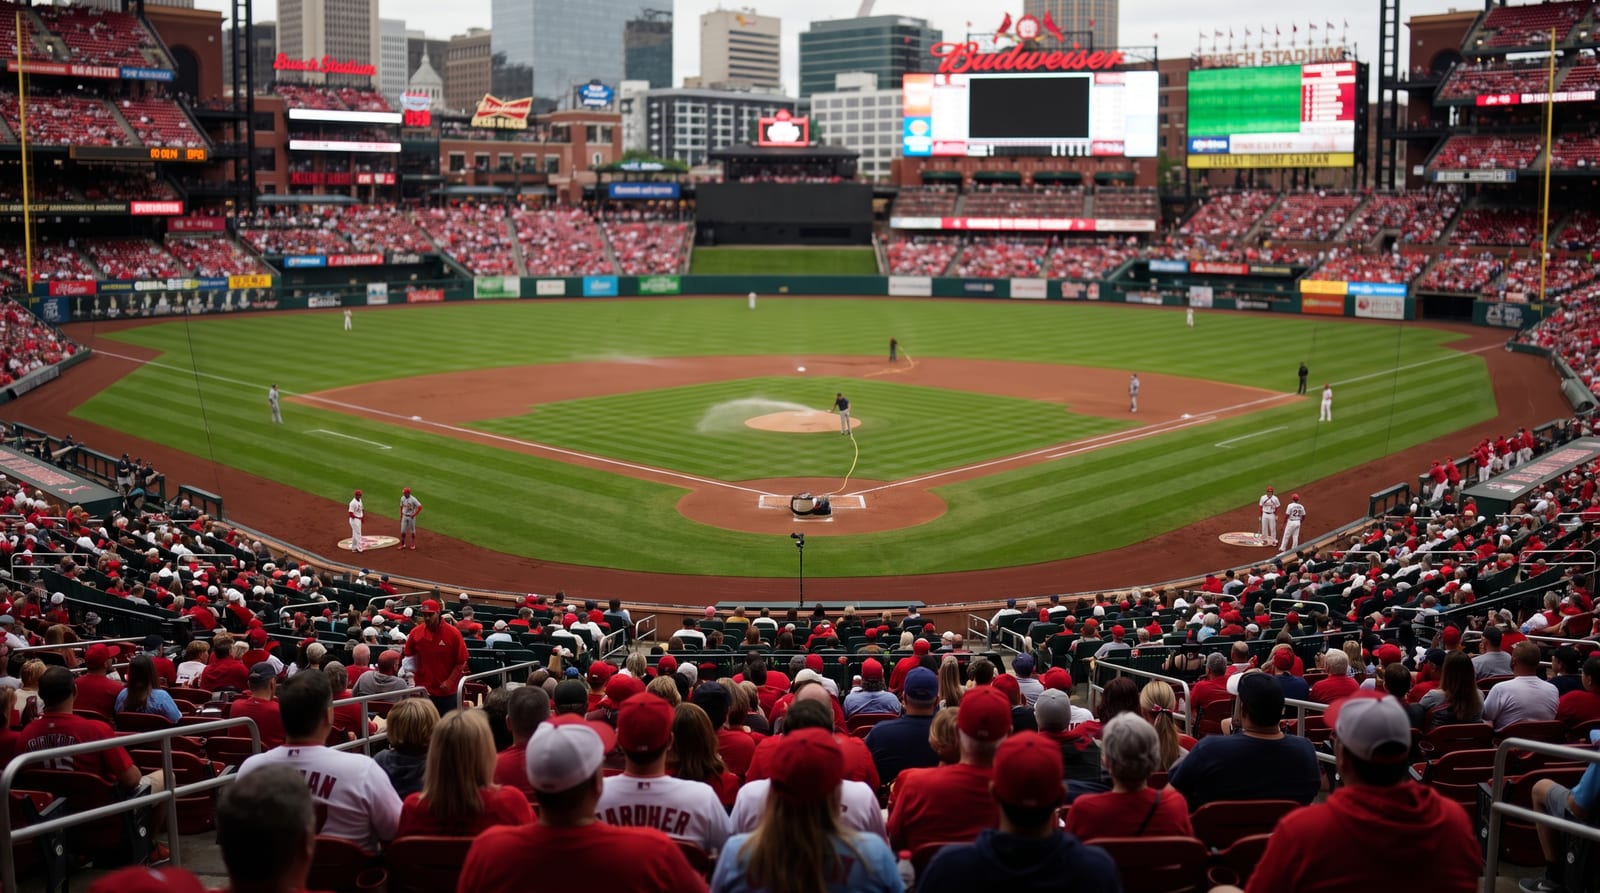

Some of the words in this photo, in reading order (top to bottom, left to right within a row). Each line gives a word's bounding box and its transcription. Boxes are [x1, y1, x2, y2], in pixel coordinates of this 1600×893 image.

[272, 52, 318, 72] Busch
[320, 54, 376, 76] Stadium
[930, 41, 1125, 73] Budweiser
[1261, 47, 1343, 64] STADIUM
[597, 804, 691, 836] ARDHER
